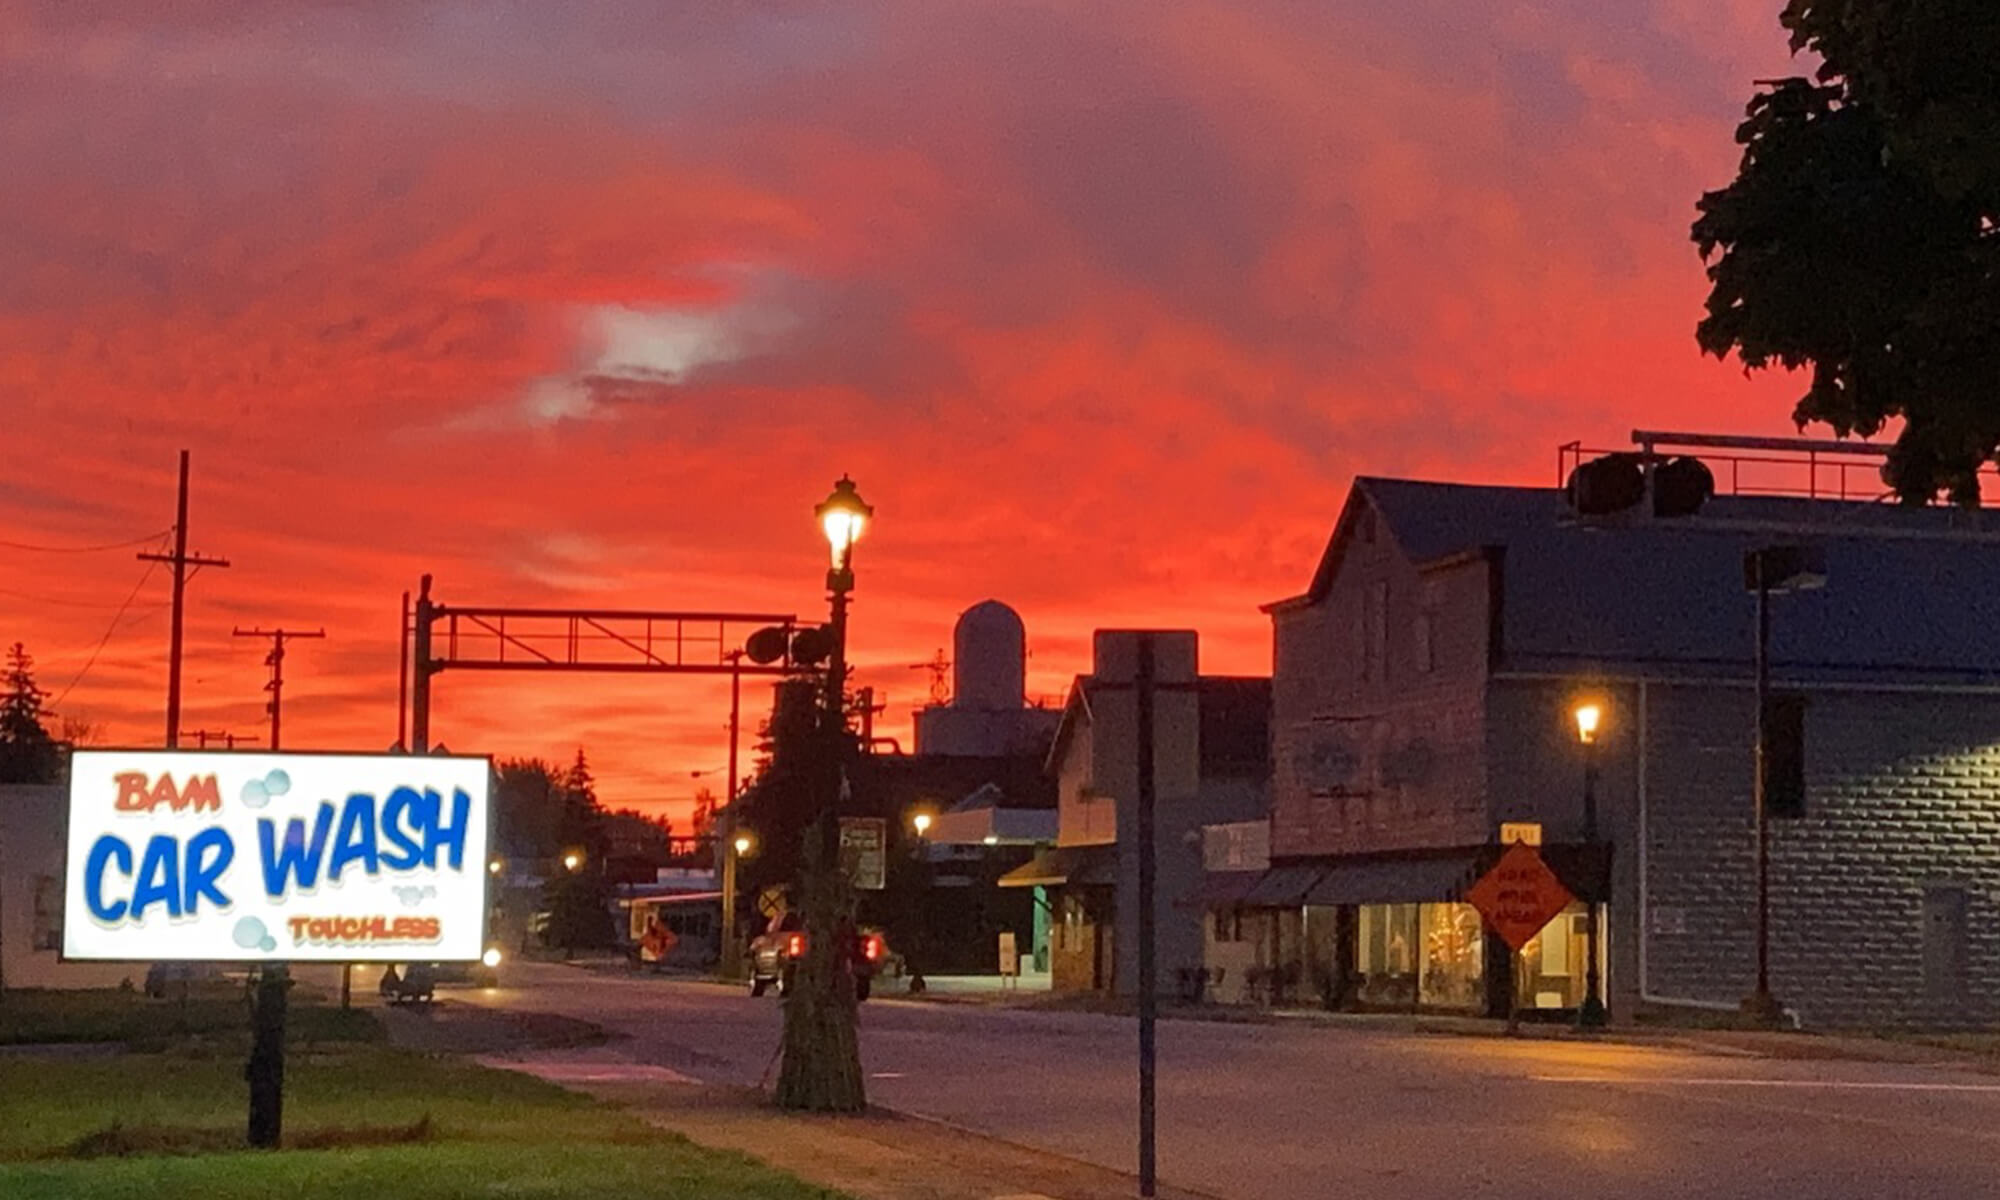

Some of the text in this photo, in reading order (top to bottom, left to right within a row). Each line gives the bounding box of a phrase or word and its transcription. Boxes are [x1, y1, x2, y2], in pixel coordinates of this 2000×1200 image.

[114, 770, 221, 812] BAM
[84, 784, 471, 922] CAR WASH
[288, 916, 441, 941] TOUCHLESS
